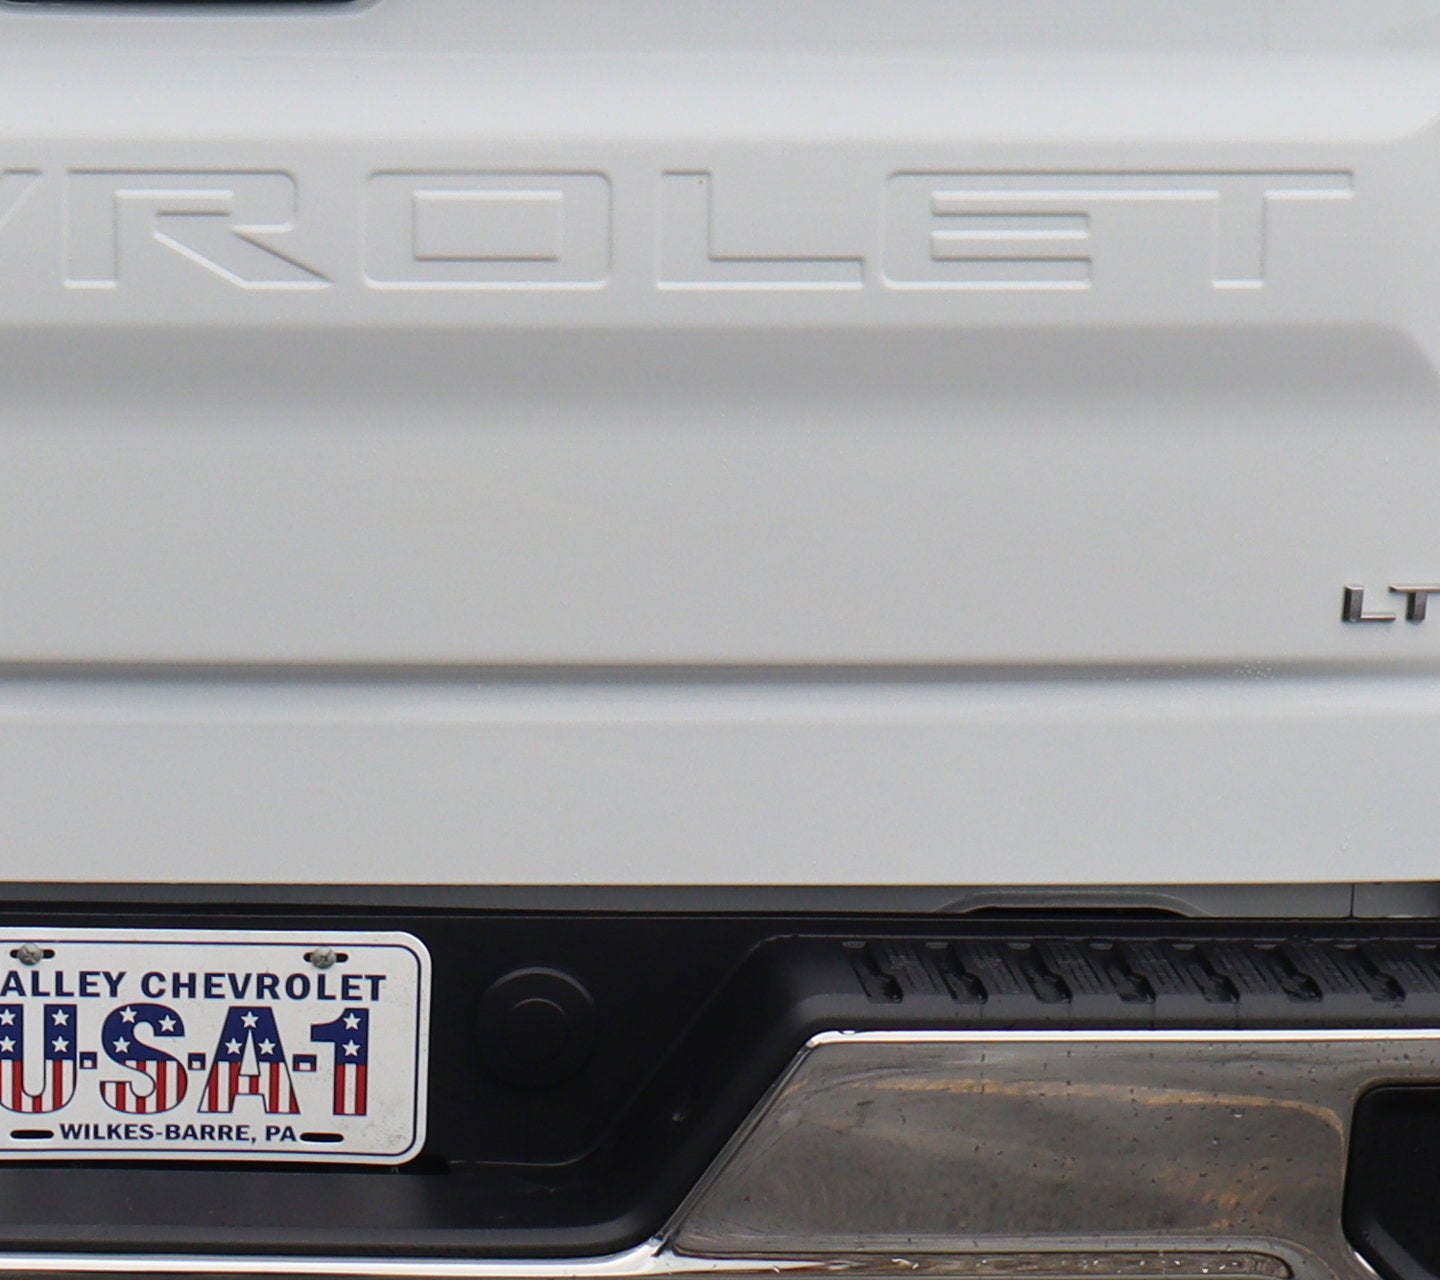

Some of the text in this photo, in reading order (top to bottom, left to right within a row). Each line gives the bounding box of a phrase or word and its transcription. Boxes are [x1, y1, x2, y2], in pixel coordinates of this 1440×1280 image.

[140, 971, 387, 1002] CHEVROLET
[59, 1123, 298, 1144] WILKES-BARRE, PA
